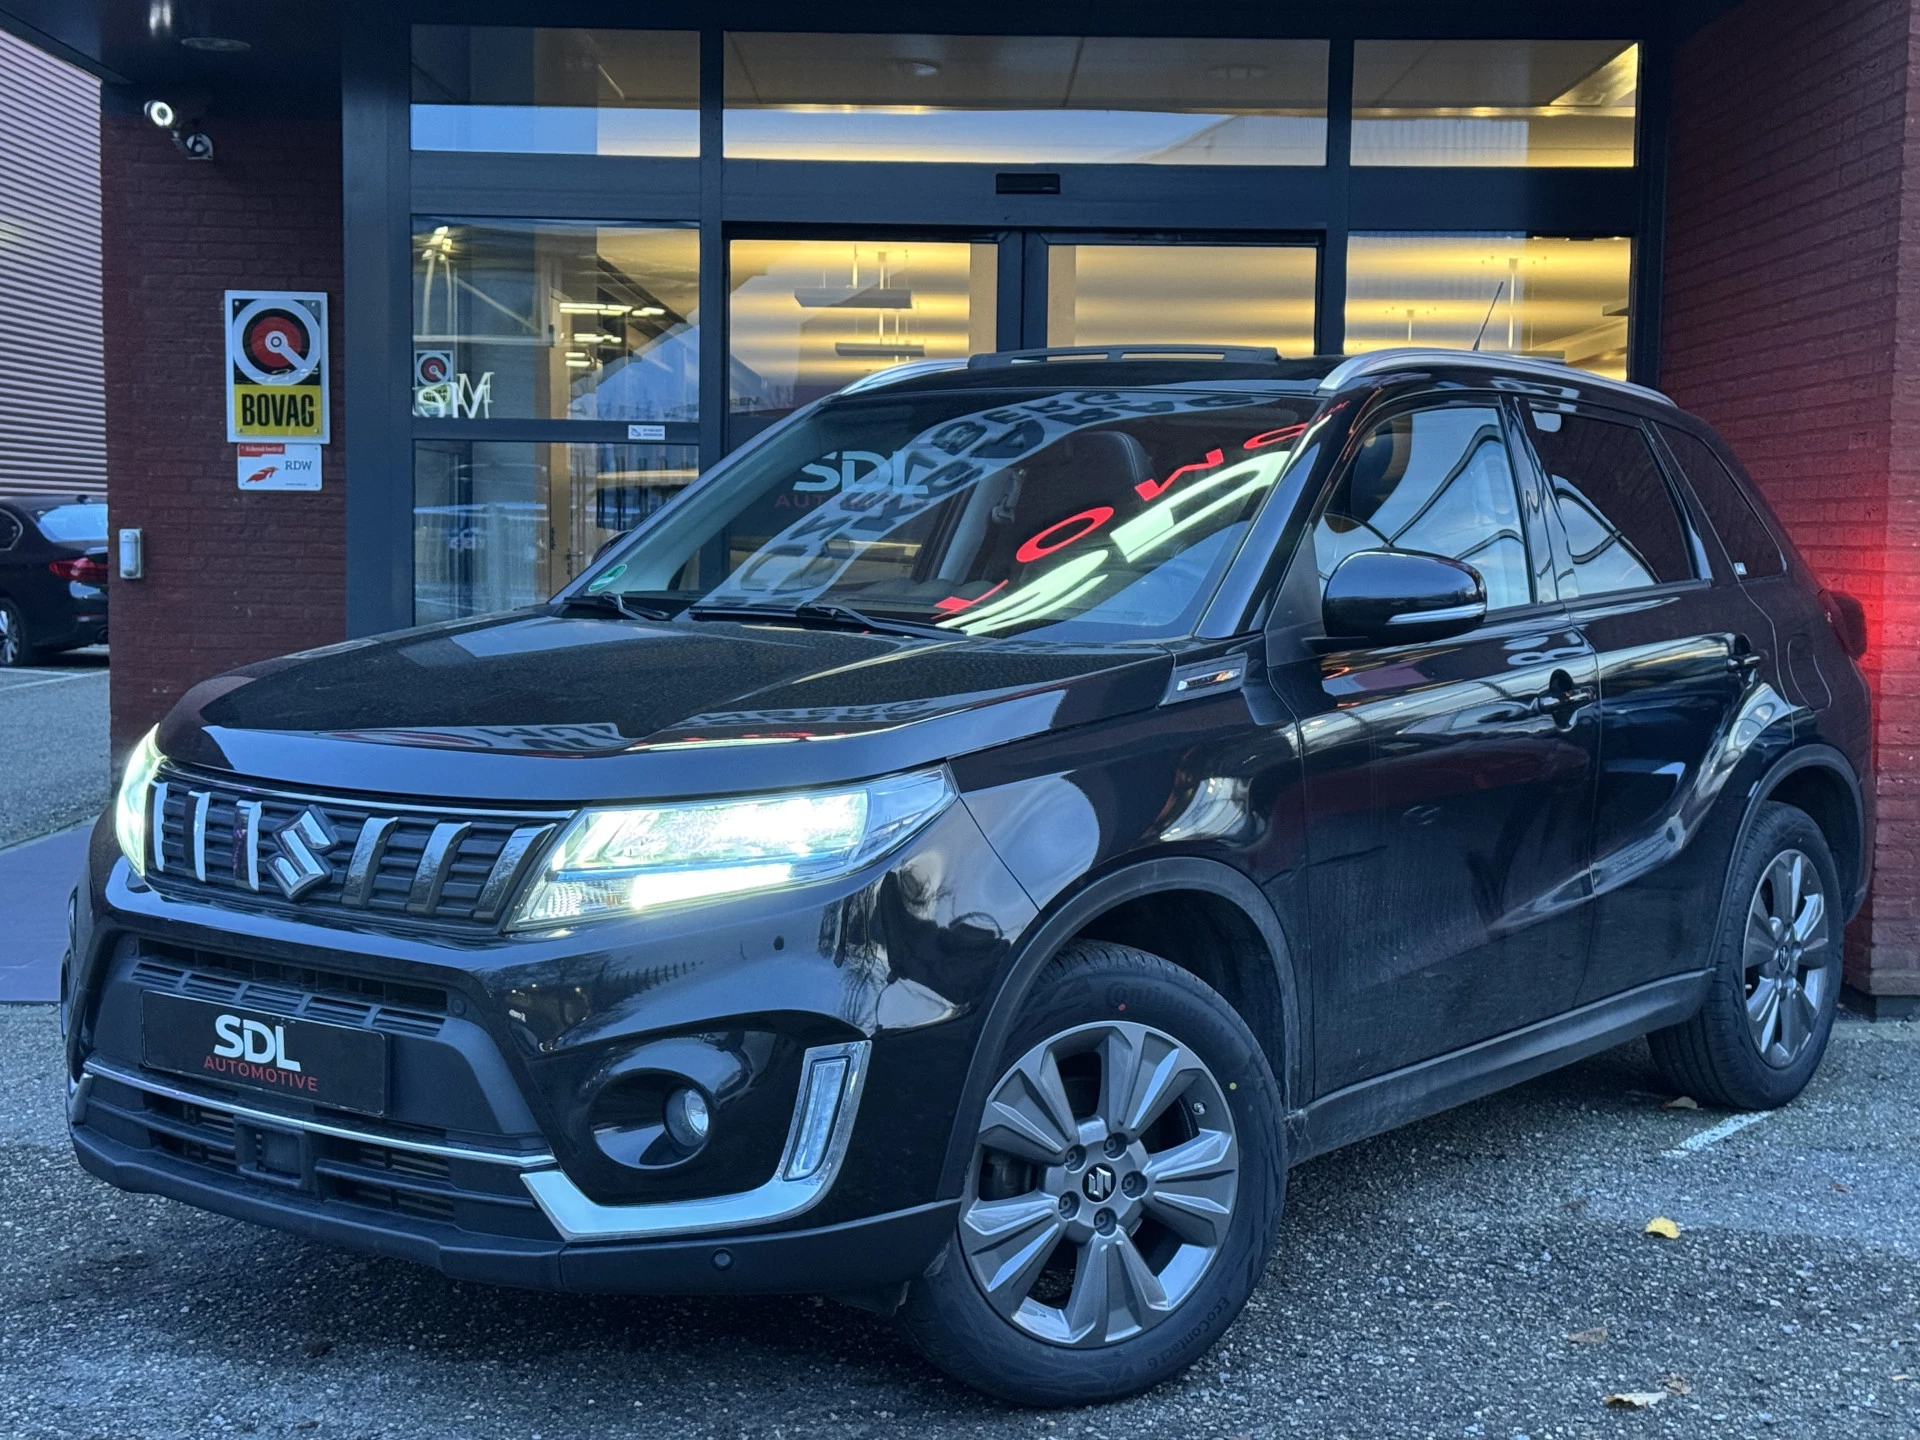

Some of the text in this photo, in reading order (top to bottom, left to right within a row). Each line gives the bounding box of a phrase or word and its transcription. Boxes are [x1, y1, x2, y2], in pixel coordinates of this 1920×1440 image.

[241, 393, 315, 428] BOVAG
[285, 460, 312, 471] RDW
[793, 450, 929, 495] SDL
[213, 1014, 302, 1072] SDL
[204, 1055, 318, 1092] AUTOMOTIVE
